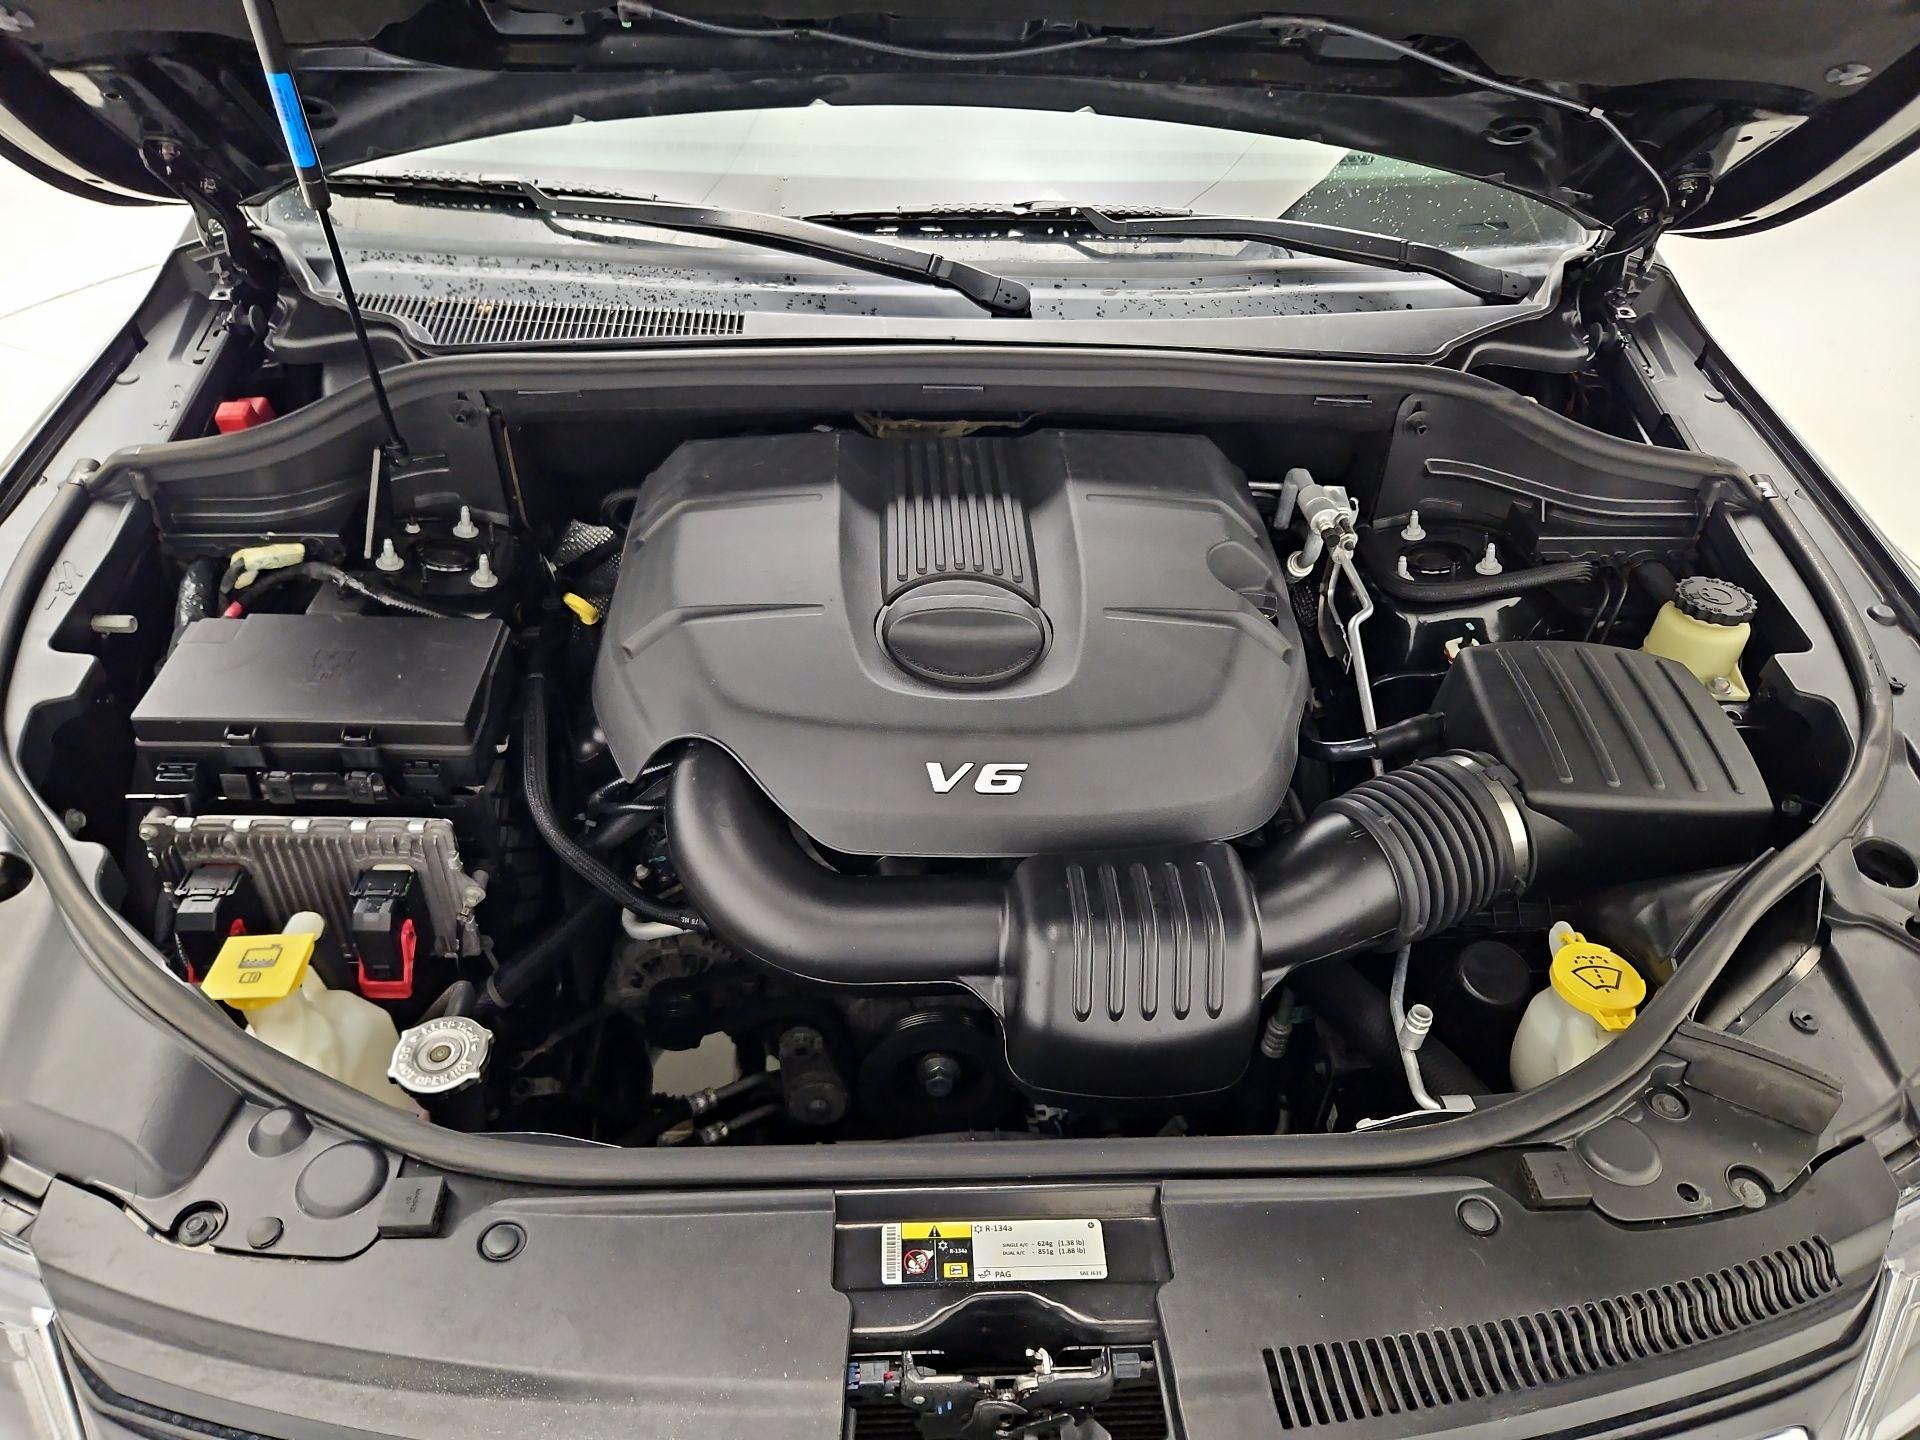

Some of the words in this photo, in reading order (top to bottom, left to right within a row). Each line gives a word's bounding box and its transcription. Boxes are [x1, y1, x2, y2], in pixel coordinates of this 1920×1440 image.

[925, 762, 1029, 794] V6
[415, 1072, 449, 1086] OPEN
[985, 1224, 1013, 1232] R-134a
[1037, 1240, 1054, 1248] 624g
[1075, 1239, 1085, 1247] lb)
[1037, 1248, 1054, 1256] 851g
[1076, 1247, 1086, 1255] lb)
[994, 1270, 1012, 1278] PAG
